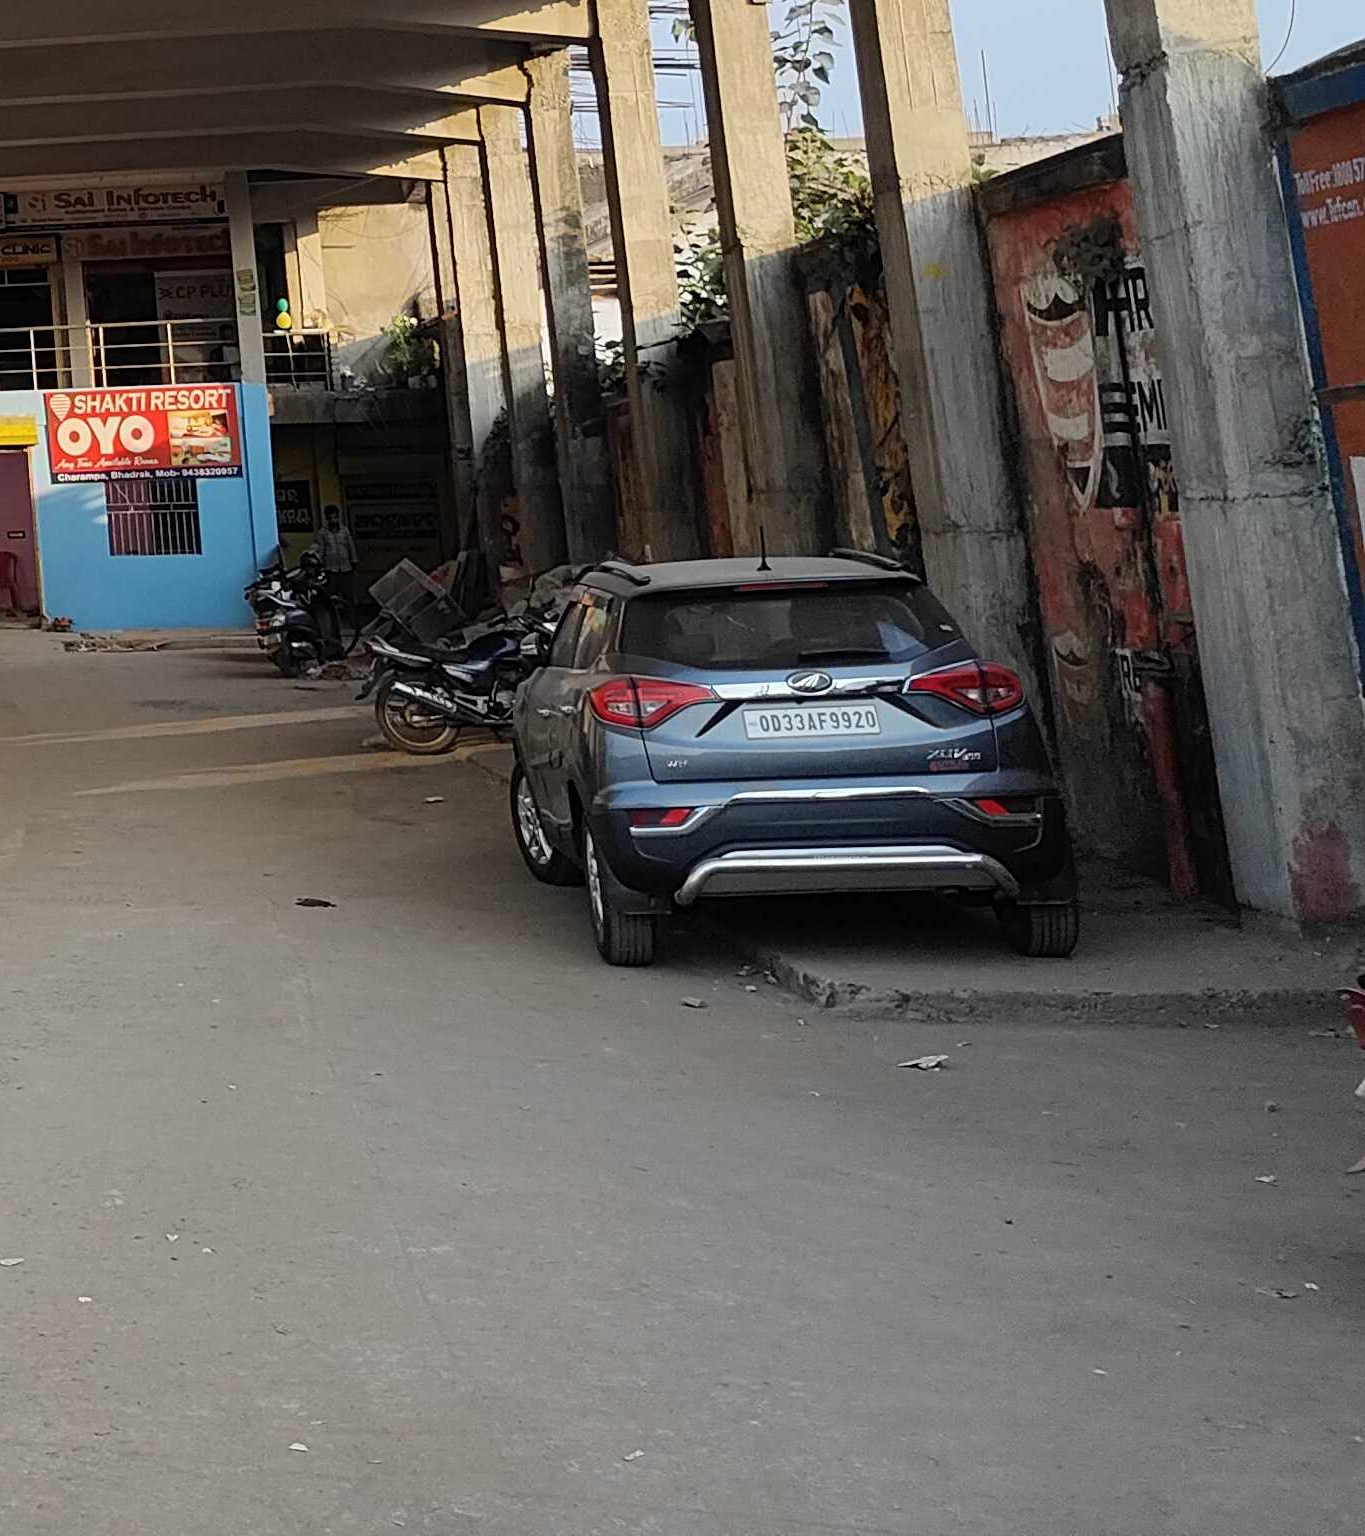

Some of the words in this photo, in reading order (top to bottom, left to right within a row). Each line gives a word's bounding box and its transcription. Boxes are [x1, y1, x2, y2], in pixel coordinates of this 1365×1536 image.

[0, 243, 52, 256] CLINIC
[74, 393, 146, 414] SHAKTI
[150, 389, 230, 411] RESORT
[57, 415, 154, 456] OYO
[759, 710, 876, 733] OD33AF9920
